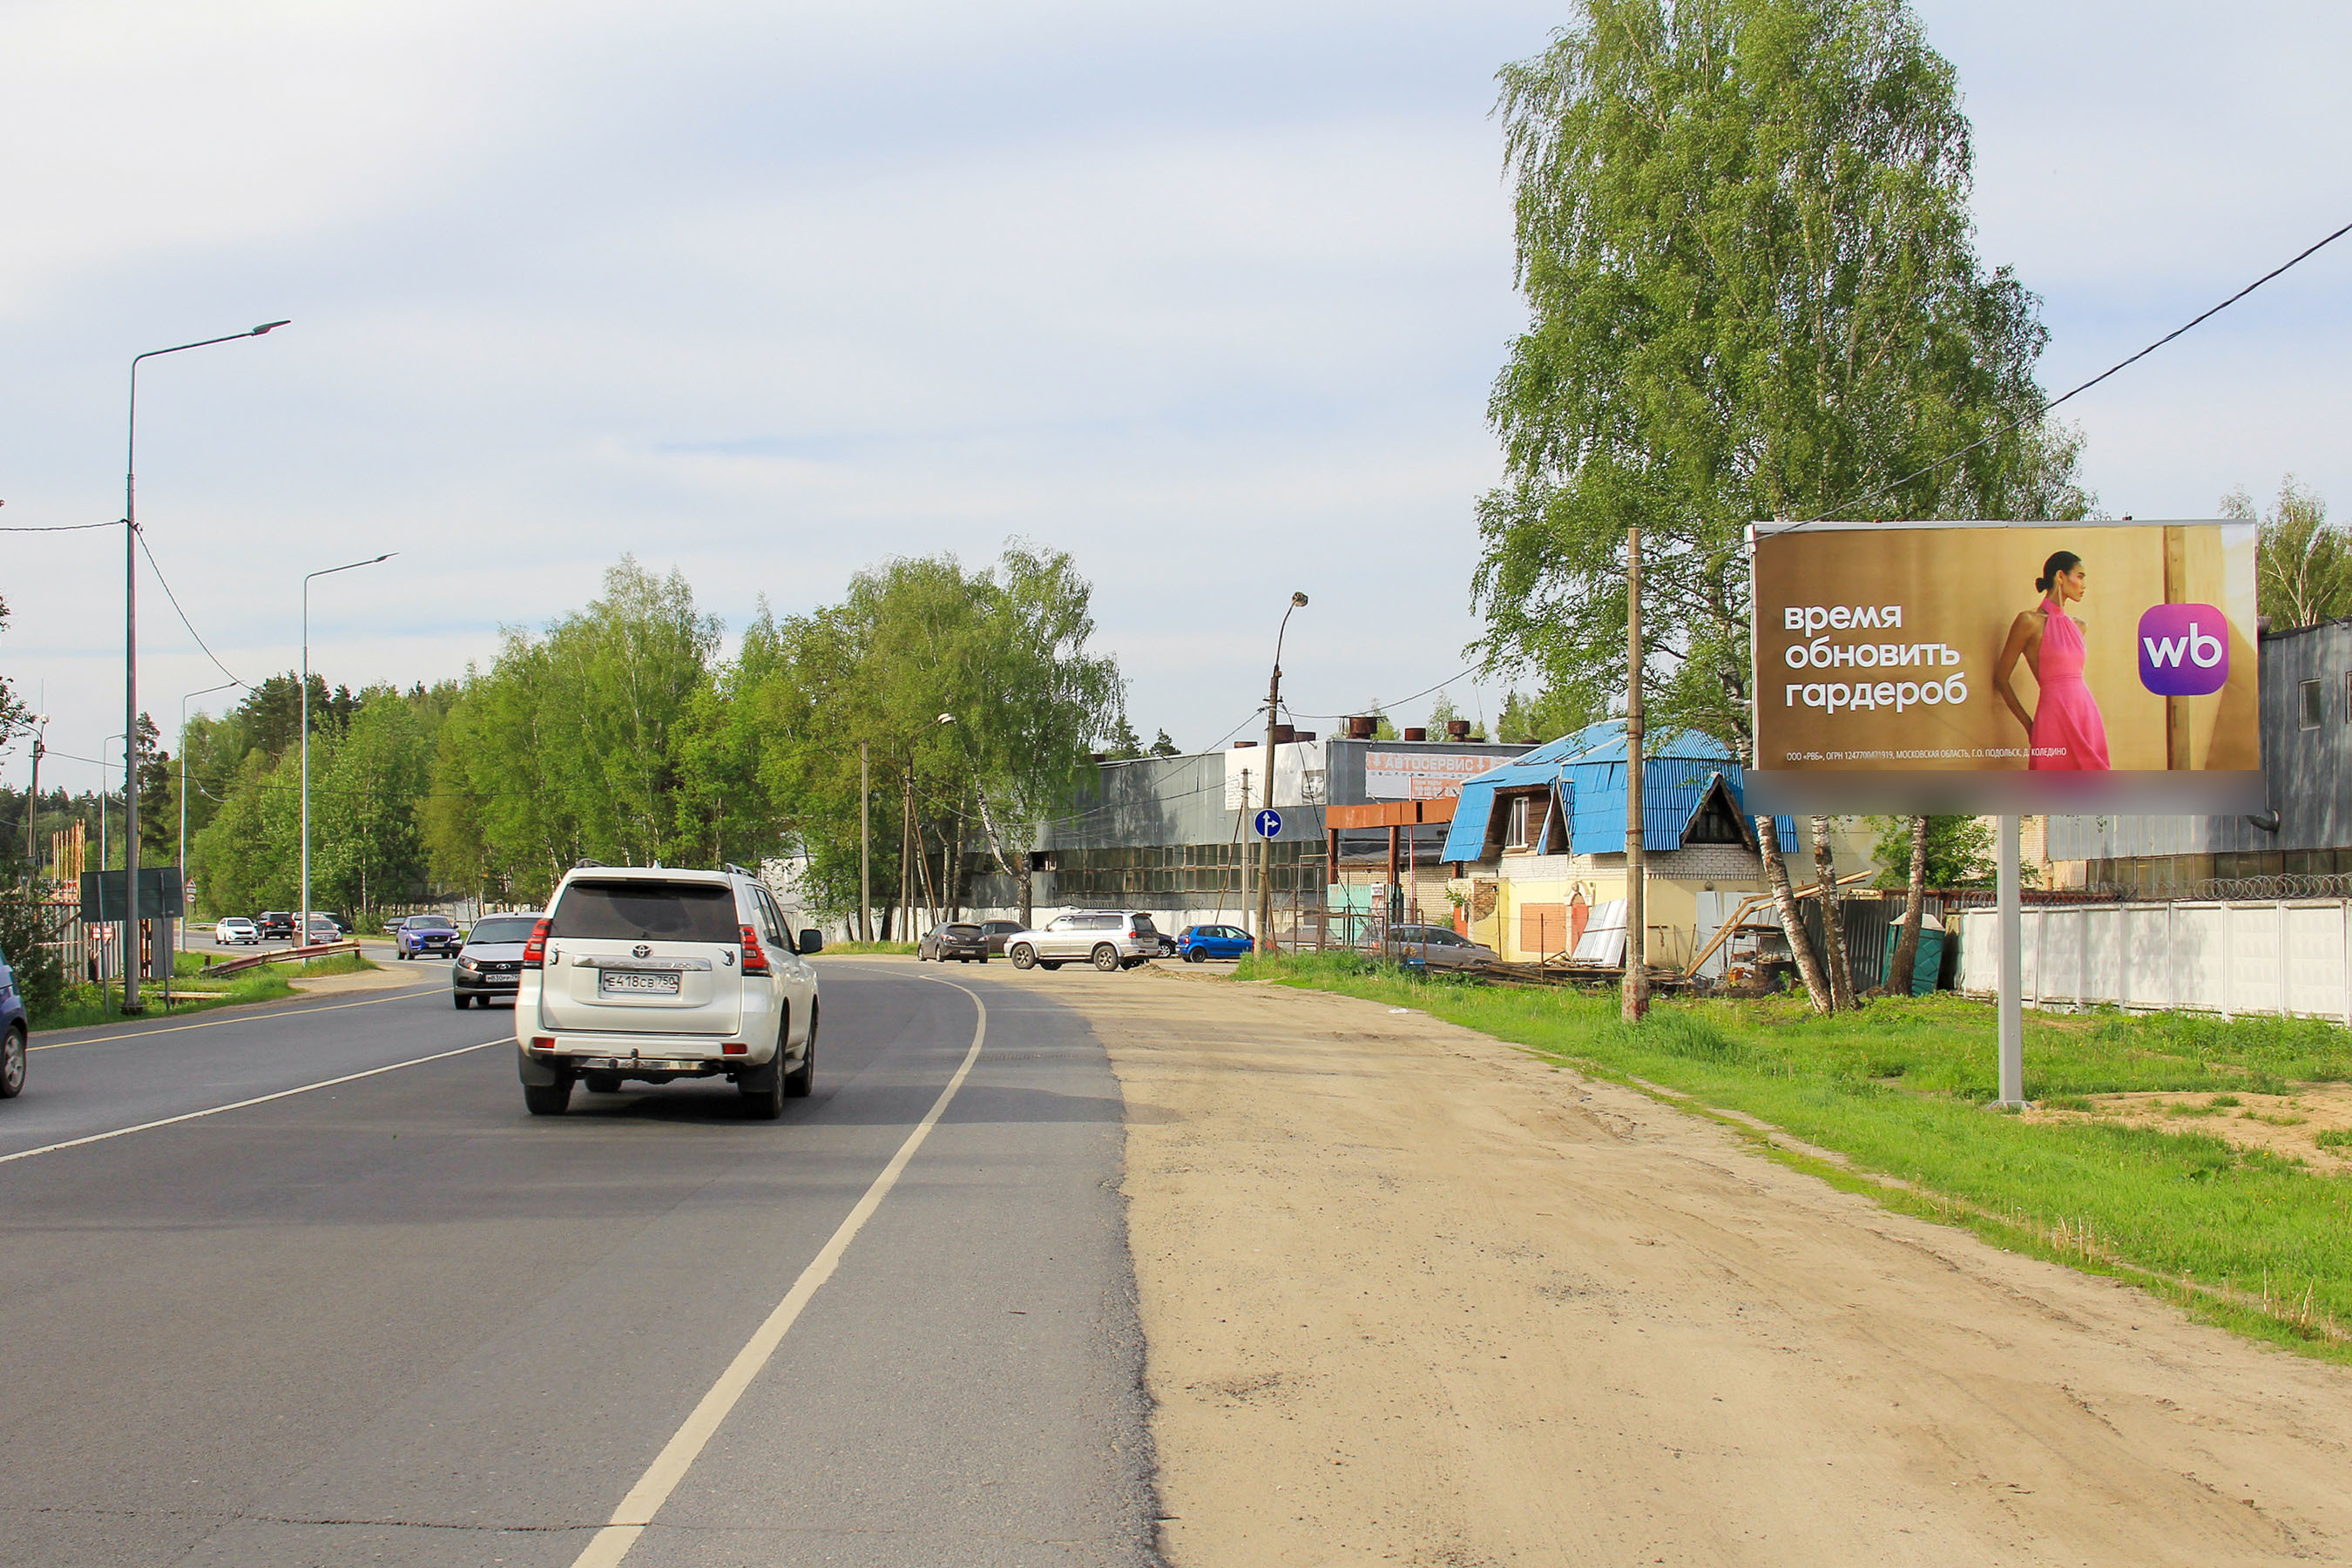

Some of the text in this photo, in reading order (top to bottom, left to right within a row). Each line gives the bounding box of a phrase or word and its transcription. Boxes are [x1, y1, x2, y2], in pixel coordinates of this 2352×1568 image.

[1784, 605, 1903, 638] время
[1784, 635, 1961, 669] обновить
[2143, 622, 2223, 669] wb
[1785, 672, 1968, 714] гардероб
[1384, 755, 1474, 772] АВТОСЕРВИС
[1786, 752, 1802, 761] ООО
[1826, 750, 1843, 760] ОГРН
[1896, 749, 1940, 760] МОСКОВСКАЯ
[1940, 748, 1971, 759] ОБЛАСТЬ,
[1971, 748, 1984, 758] Г.О.
[1985, 747, 2022, 759] ПОДОЛЬСК,
[2031, 747, 2067, 758] КОЛЕДИНО
